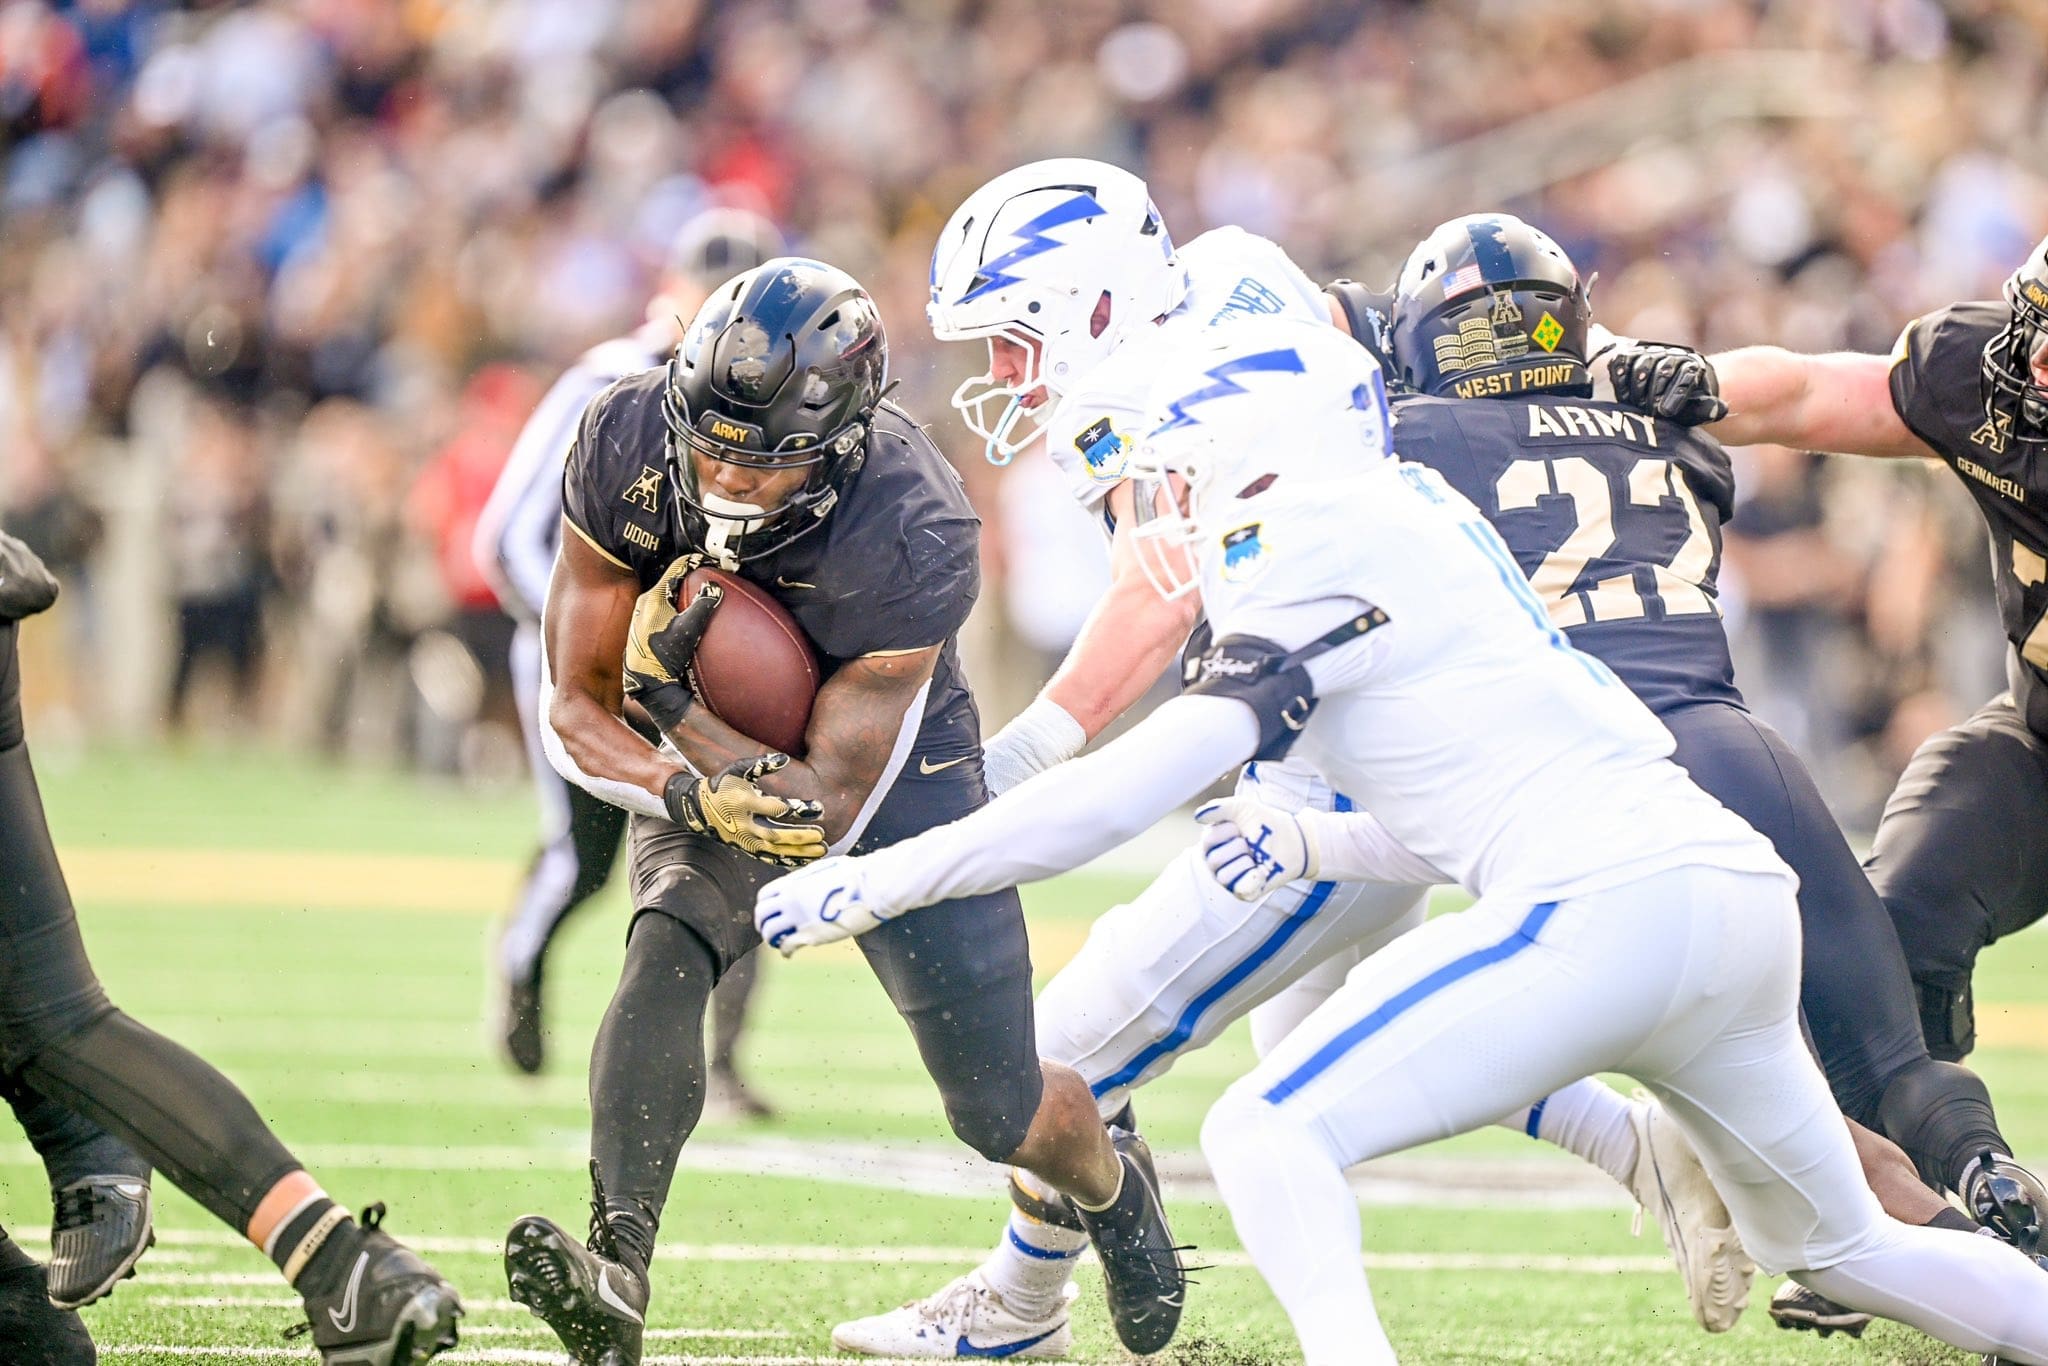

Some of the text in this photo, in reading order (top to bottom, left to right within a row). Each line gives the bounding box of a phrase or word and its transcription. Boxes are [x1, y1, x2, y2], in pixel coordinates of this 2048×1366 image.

[1454, 364, 1574, 399] WEST POINT
[711, 421, 749, 443] ARMY
[1528, 404, 1658, 447] ARMY
[622, 464, 664, 513] A
[1957, 456, 2025, 503] GENNARELLI
[623, 521, 660, 552] UDOH
[1495, 456, 1714, 629] 22
